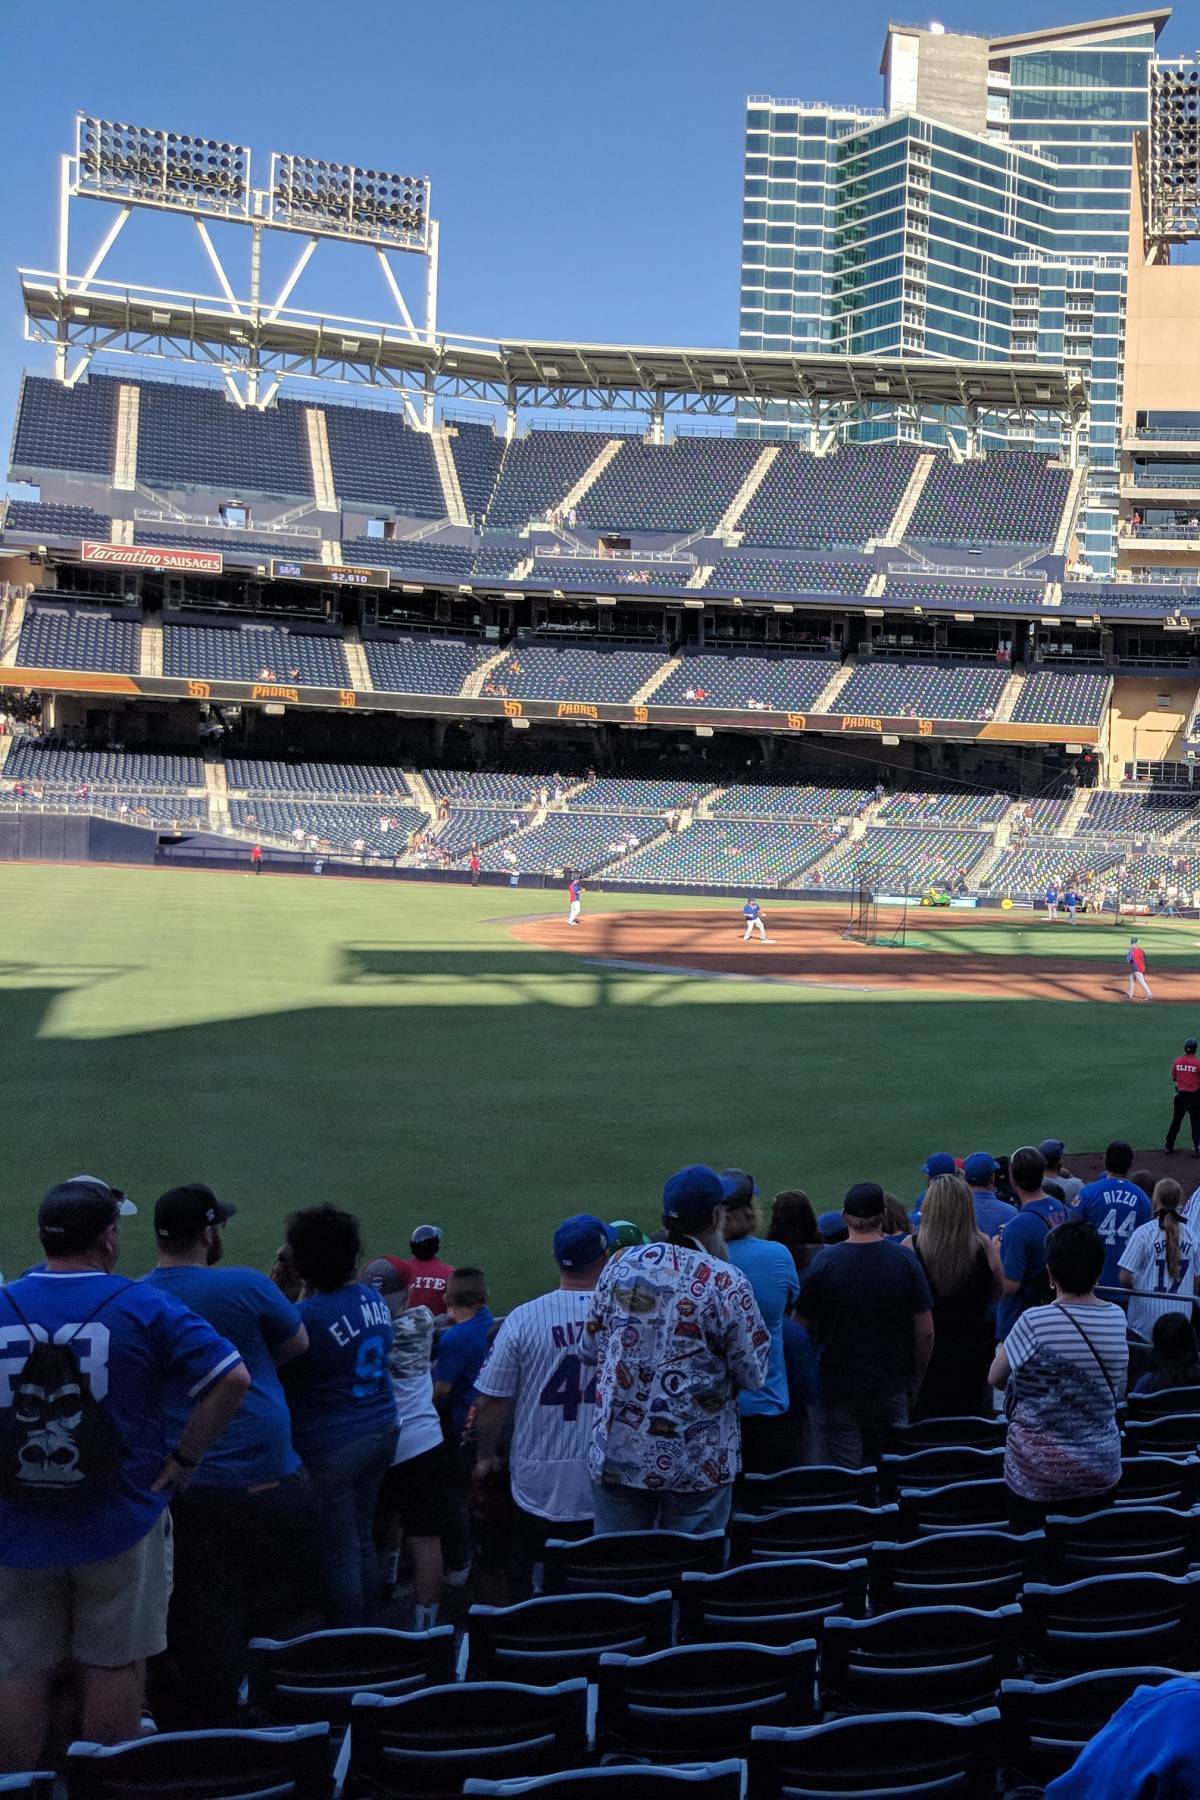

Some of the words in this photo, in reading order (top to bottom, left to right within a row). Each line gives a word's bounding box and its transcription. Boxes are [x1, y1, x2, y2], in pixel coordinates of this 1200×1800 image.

[87, 544, 161, 565] Tarantino
[163, 555, 220, 570] SAUSAGES
[280, 565, 301, 575] 50/50
[252, 685, 299, 702] PADRES
[557, 703, 599, 719] PADRES
[841, 717, 883, 732] PADRES
[1176, 1064, 1198, 1073] ELITE
[1103, 1190, 1138, 1208] RIZZO
[1098, 1208, 1138, 1246] 44
[1154, 1241, 1192, 1255] BRNT
[410, 1276, 446, 1290] ITE
[1154, 1259, 1190, 1294] 17
[329, 1315, 360, 1347] EL
[551, 1320, 585, 1348] RIZ
[352, 1335, 384, 1397] 9
